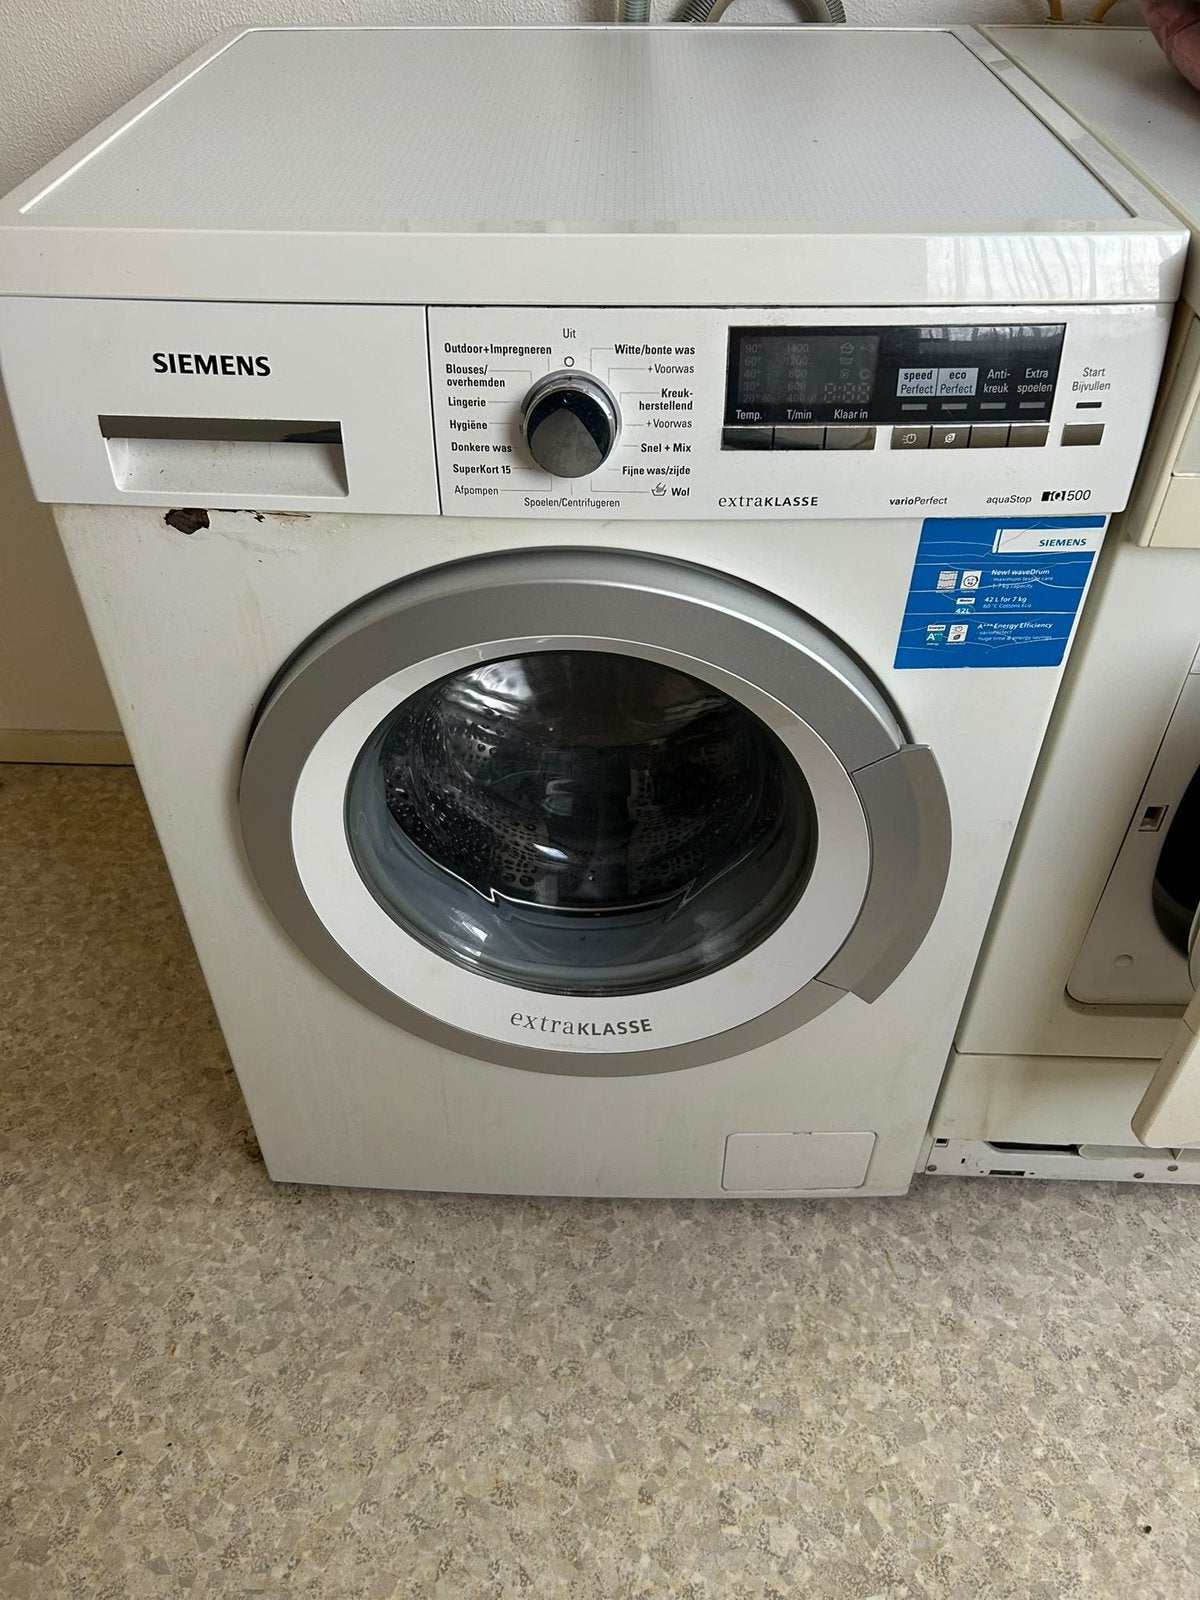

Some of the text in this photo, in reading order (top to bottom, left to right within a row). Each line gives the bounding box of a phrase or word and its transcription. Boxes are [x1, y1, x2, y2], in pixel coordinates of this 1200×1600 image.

[563, 328, 576, 339] Uit
[444, 343, 552, 355] Outdoor+Impregneren
[615, 344, 695, 355] Witte/bonte was
[152, 353, 271, 376] SIEMENS
[446, 364, 488, 375] Blouses/
[903, 370, 933, 381] speed
[987, 369, 1010, 379] Anti-
[1025, 368, 1048, 378] Extra
[1083, 367, 1105, 377] Start
[447, 377, 505, 388] overhemden
[983, 383, 1009, 393] kreuk
[1017, 382, 1052, 393] spoelen
[1072, 382, 1110, 393] Bijvullen
[661, 388, 693, 398] Kreuk-
[901, 384, 933, 394] Perfect
[940, 384, 973, 394] Perfect
[448, 397, 486, 408] Lingerie
[639, 401, 693, 411] herstellend
[736, 409, 762, 420] Temp.
[787, 409, 812, 419] T/min
[834, 409, 868, 419] Klaar in
[450, 420, 488, 432] Hygiëne
[451, 442, 512, 453] Donkere was
[641, 443, 661, 453] Snel
[673, 443, 691, 453] Mix
[453, 464, 511, 475] SuperKort 15
[622, 466, 691, 477] Fijne was/zijde
[454, 485, 499, 496] Afpompen
[671, 487, 690, 496] Wol
[524, 498, 620, 509] Spoelen/Centrifugeren
[889, 496, 947, 505] varioPerfect
[986, 495, 1032, 504] aquaStop
[1039, 539, 1087, 547] SIEMENS
[510, 1012, 652, 1035] extraKLASSE
